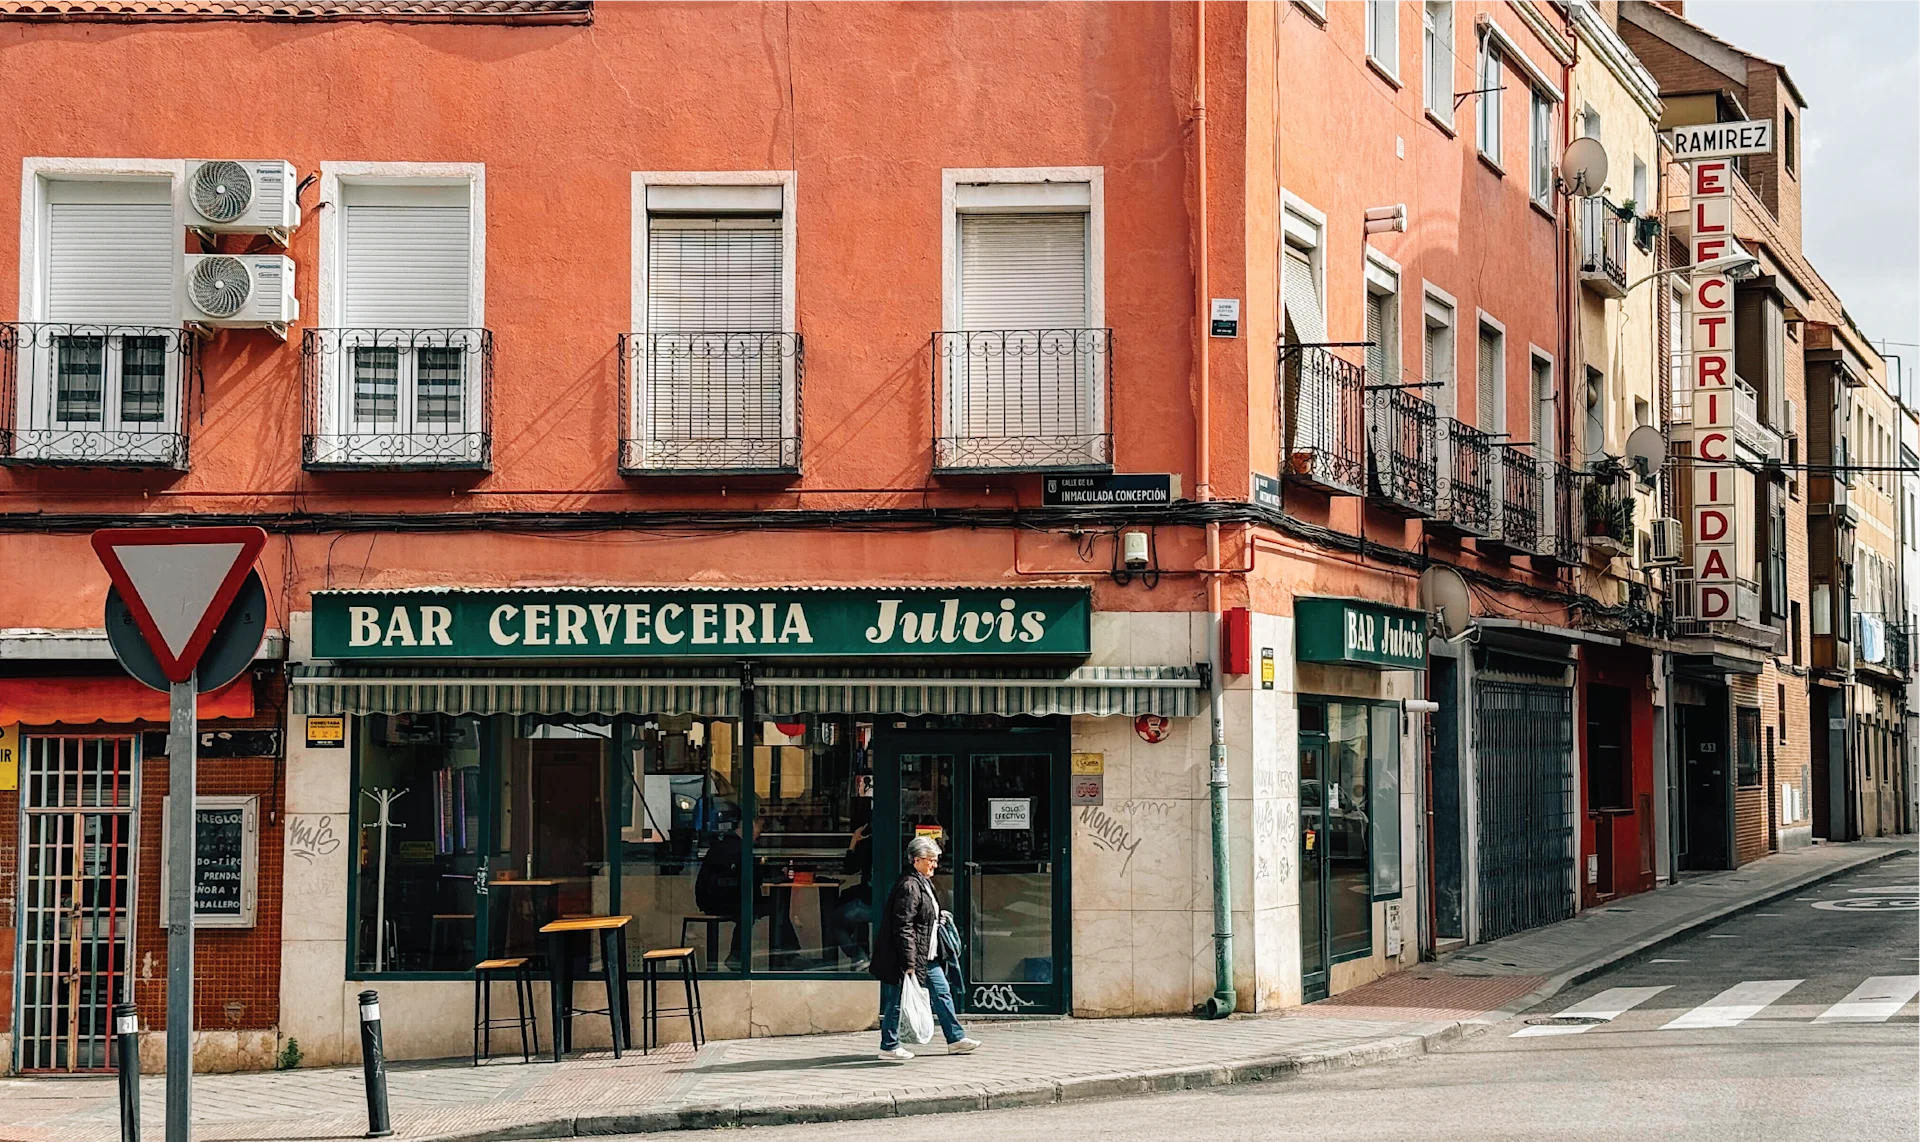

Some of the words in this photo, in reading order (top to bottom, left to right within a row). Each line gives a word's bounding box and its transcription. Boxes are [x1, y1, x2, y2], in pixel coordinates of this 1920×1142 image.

[1675, 126, 1767, 153] RAMIREZ
[1062, 490, 1113, 502] INMACULADA
[1115, 487, 1166, 501] CONCEPCIÓN
[348, 606, 453, 647] BAR
[489, 603, 814, 646] CERVECERIA
[865, 598, 1046, 644] Julvis
[1348, 611, 1375, 652] BAR
[1381, 616, 1423, 660] Julvis
[995, 812, 1025, 820] EFECTIVO
